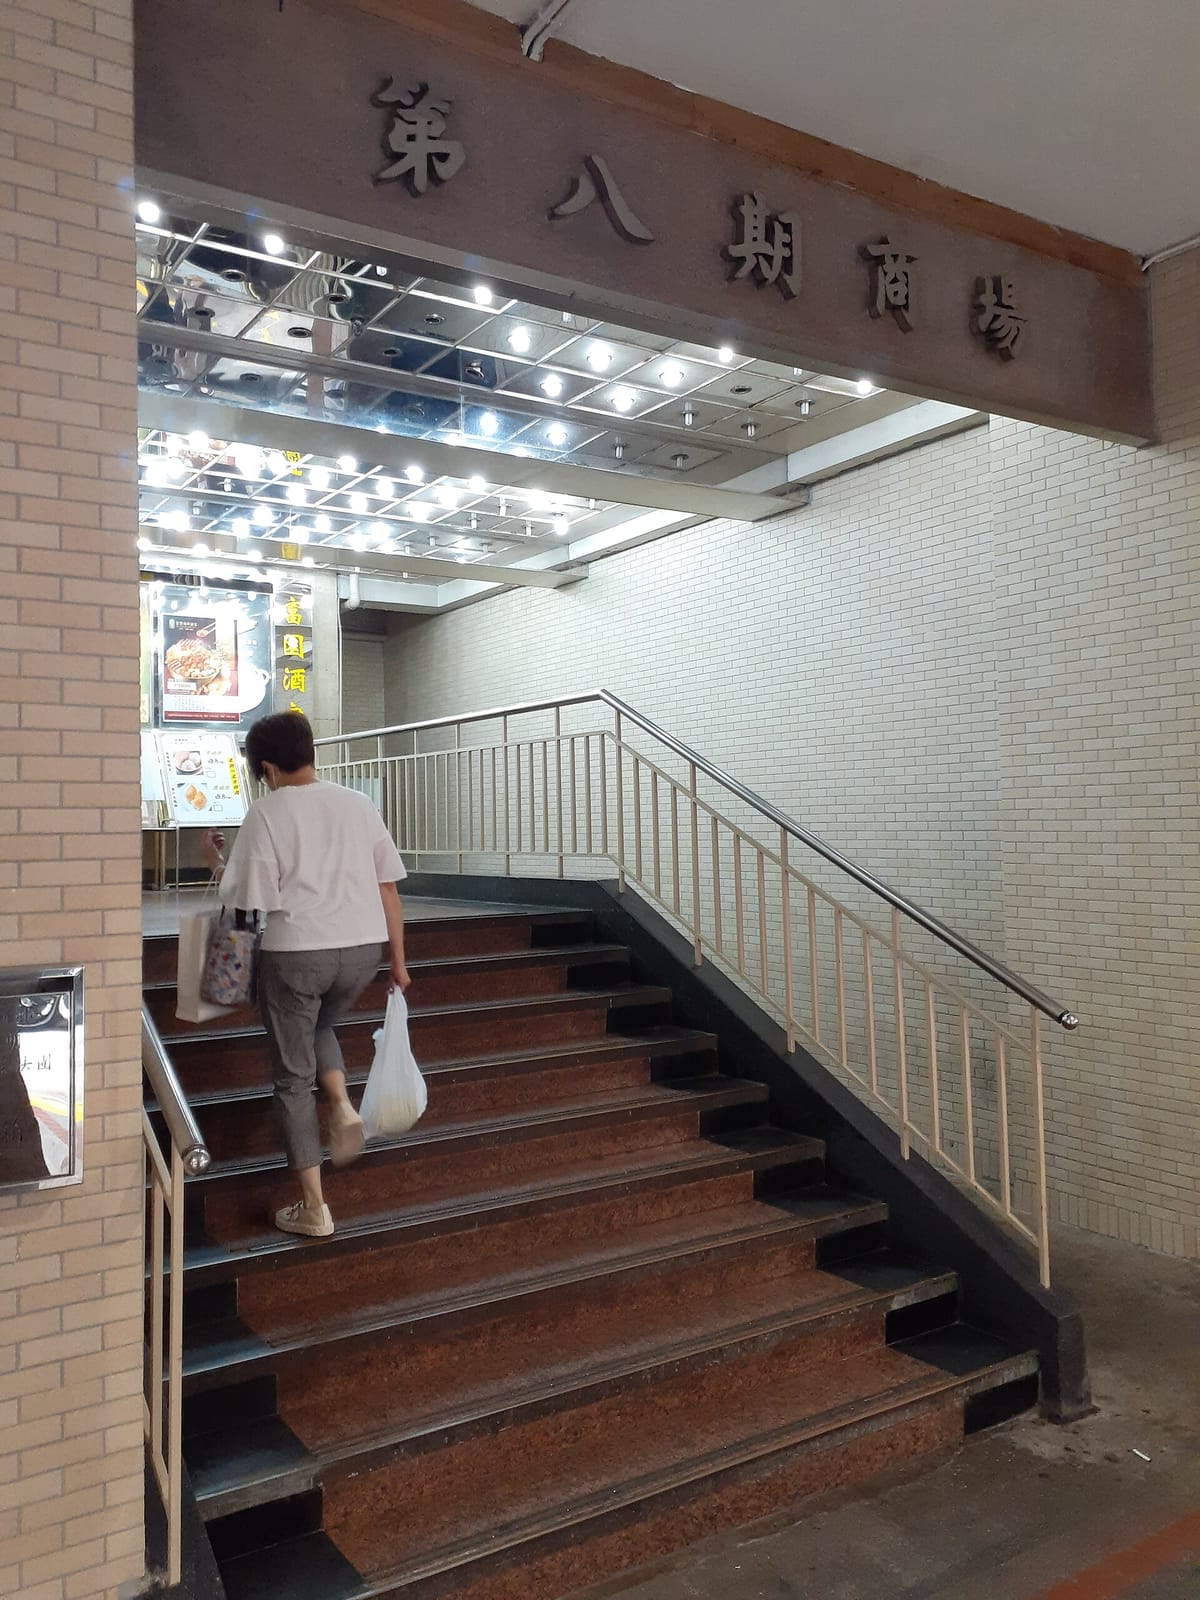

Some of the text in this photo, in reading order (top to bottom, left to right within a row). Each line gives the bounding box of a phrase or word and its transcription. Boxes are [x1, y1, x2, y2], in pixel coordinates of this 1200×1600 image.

[371, 76, 1028, 360] 第八期商場
